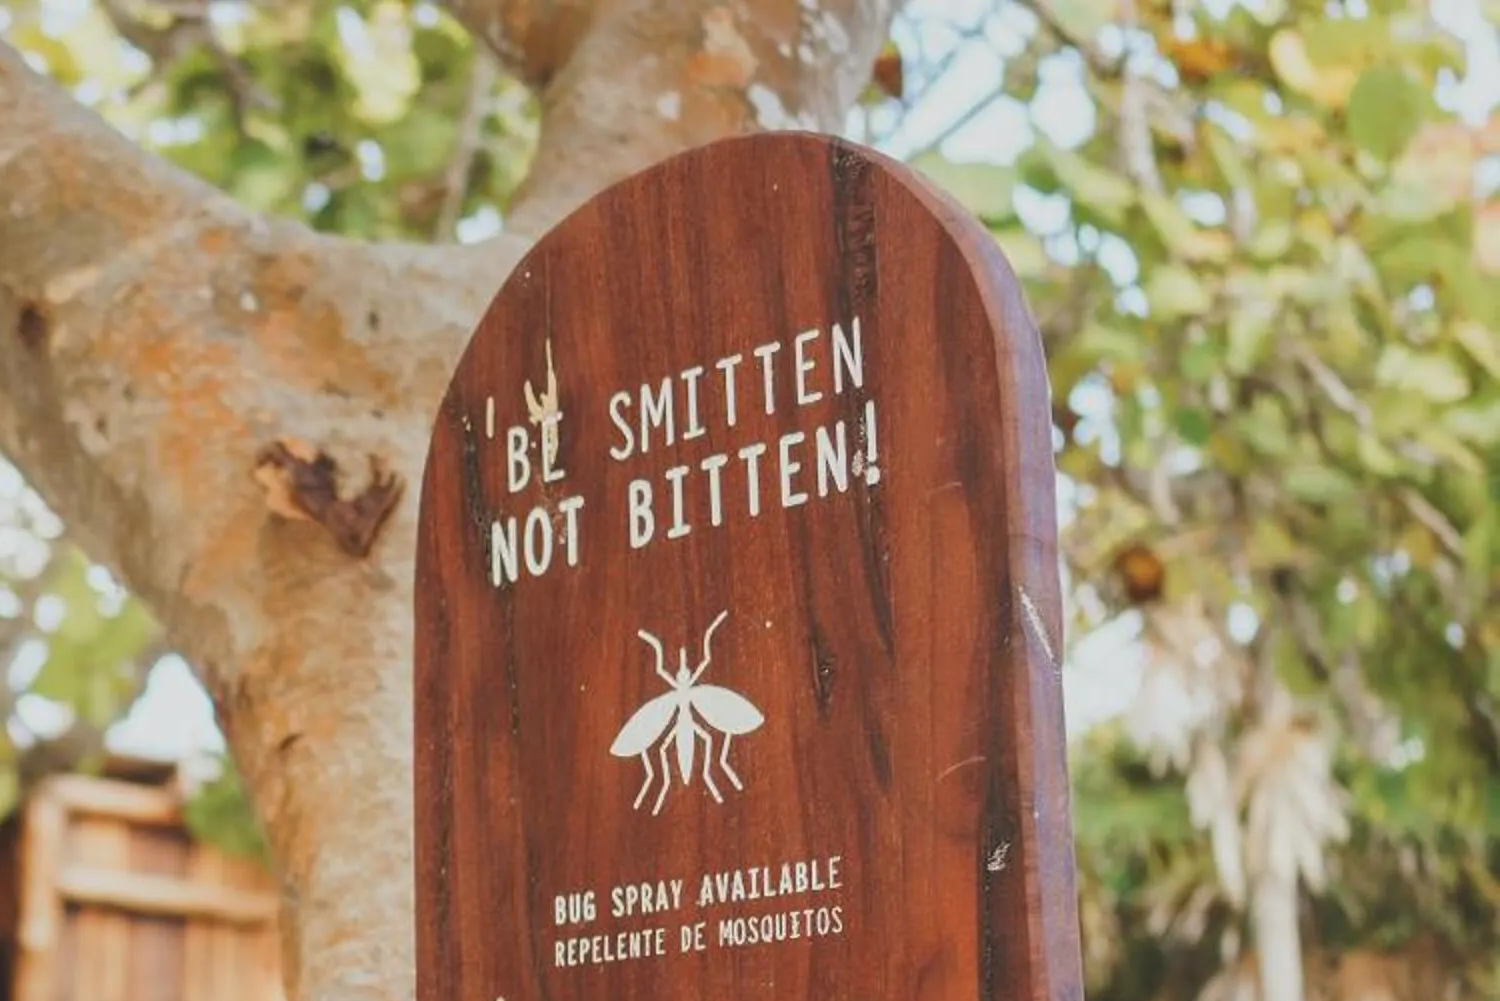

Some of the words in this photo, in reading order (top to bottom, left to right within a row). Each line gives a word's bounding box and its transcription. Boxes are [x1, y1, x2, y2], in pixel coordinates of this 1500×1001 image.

[506, 412, 566, 493] BE
[608, 315, 864, 461] SMITTEN
[490, 496, 585, 587] NOT
[627, 399, 881, 549] BITTEN!
[554, 890, 597, 925] BUG
[610, 879, 684, 918] SPRAY
[699, 855, 843, 907] AVAILABLE
[554, 927, 666, 968] REPELENTE
[680, 922, 707, 953] DE
[719, 905, 844, 948] MOSQUITOS
